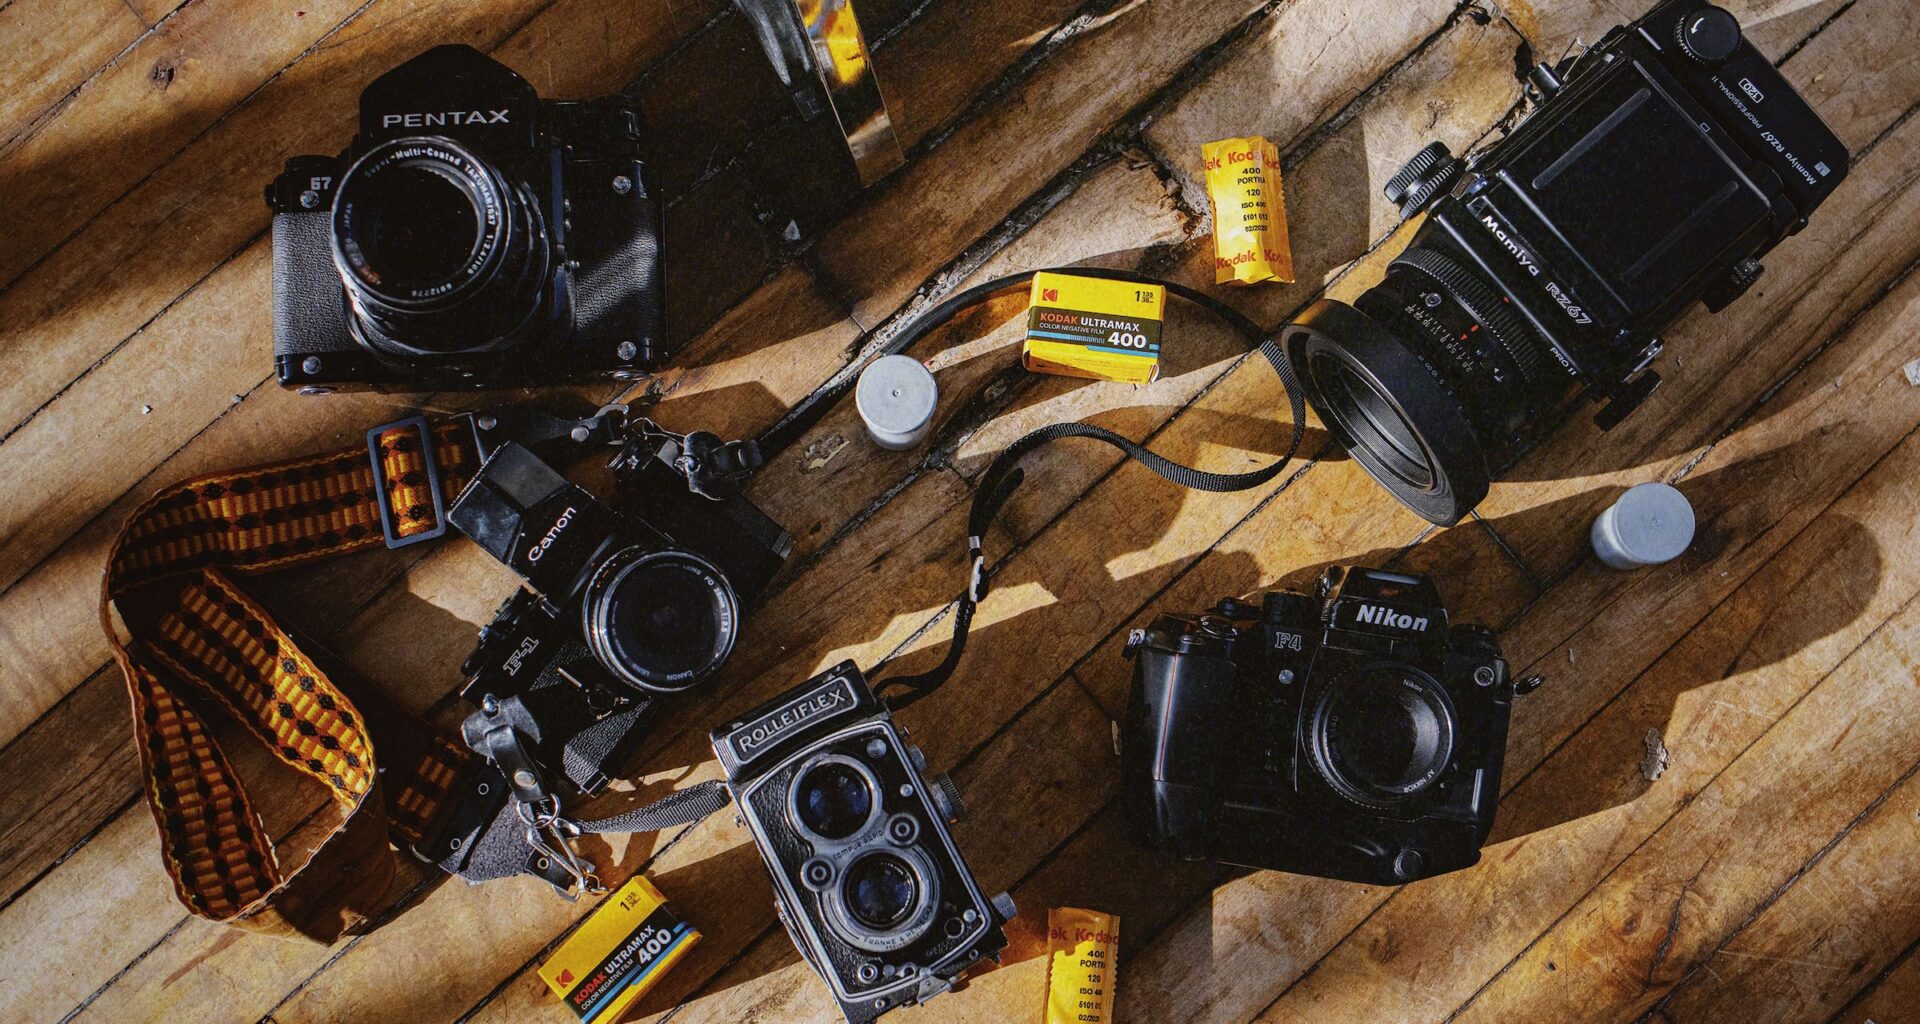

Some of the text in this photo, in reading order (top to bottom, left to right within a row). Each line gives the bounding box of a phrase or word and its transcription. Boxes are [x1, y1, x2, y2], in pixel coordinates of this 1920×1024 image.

[1742, 81, 1761, 100] 120
[1717, 80, 1763, 129] PROFESSIONAL
[383, 109, 510, 128] PENTAX
[1760, 131, 1785, 153] RZ67
[1242, 167, 1261, 175] 400
[1785, 152, 1817, 185] Mamiya
[310, 176, 332, 190] 67
[1246, 188, 1261, 197] 120
[1240, 200, 1254, 209] ISO
[1243, 213, 1257, 222] 5101
[1216, 250, 1257, 270] Kodak
[1482, 214, 1593, 324] Mamiya RZ67
[1134, 290, 1141, 302] 1
[1039, 311, 1140, 332] KODAK ULTRAMAX
[1039, 322, 1105, 335] COLOR NEGATIVE FILM
[1107, 331, 1147, 349] 400
[1550, 346, 1569, 367] PRO
[528, 505, 577, 562] Canon
[703, 575, 715, 587] FD
[1356, 604, 1429, 632] Nikon
[1274, 631, 1302, 652] F4
[502, 636, 539, 677] F-1
[666, 669, 694, 682] CANON
[1403, 679, 1423, 693] Nikon
[739, 688, 846, 753] ROLLEIFLEX
[1402, 768, 1436, 794] AF NIKKOR
[833, 829, 884, 860] COMPUR RAPID
[619, 901, 631, 912] 1
[637, 928, 672, 965] 400
[863, 935, 898, 946] FRANKE
[1087, 950, 1105, 958] 400
[573, 924, 656, 1006] KODAK ULTRAMAX
[581, 958, 634, 1011] COLOR NEGATIVE FILM
[1087, 974, 1101, 983] 120
[1079, 987, 1093, 996] ISO
[1078, 1000, 1094, 1010] 5101
